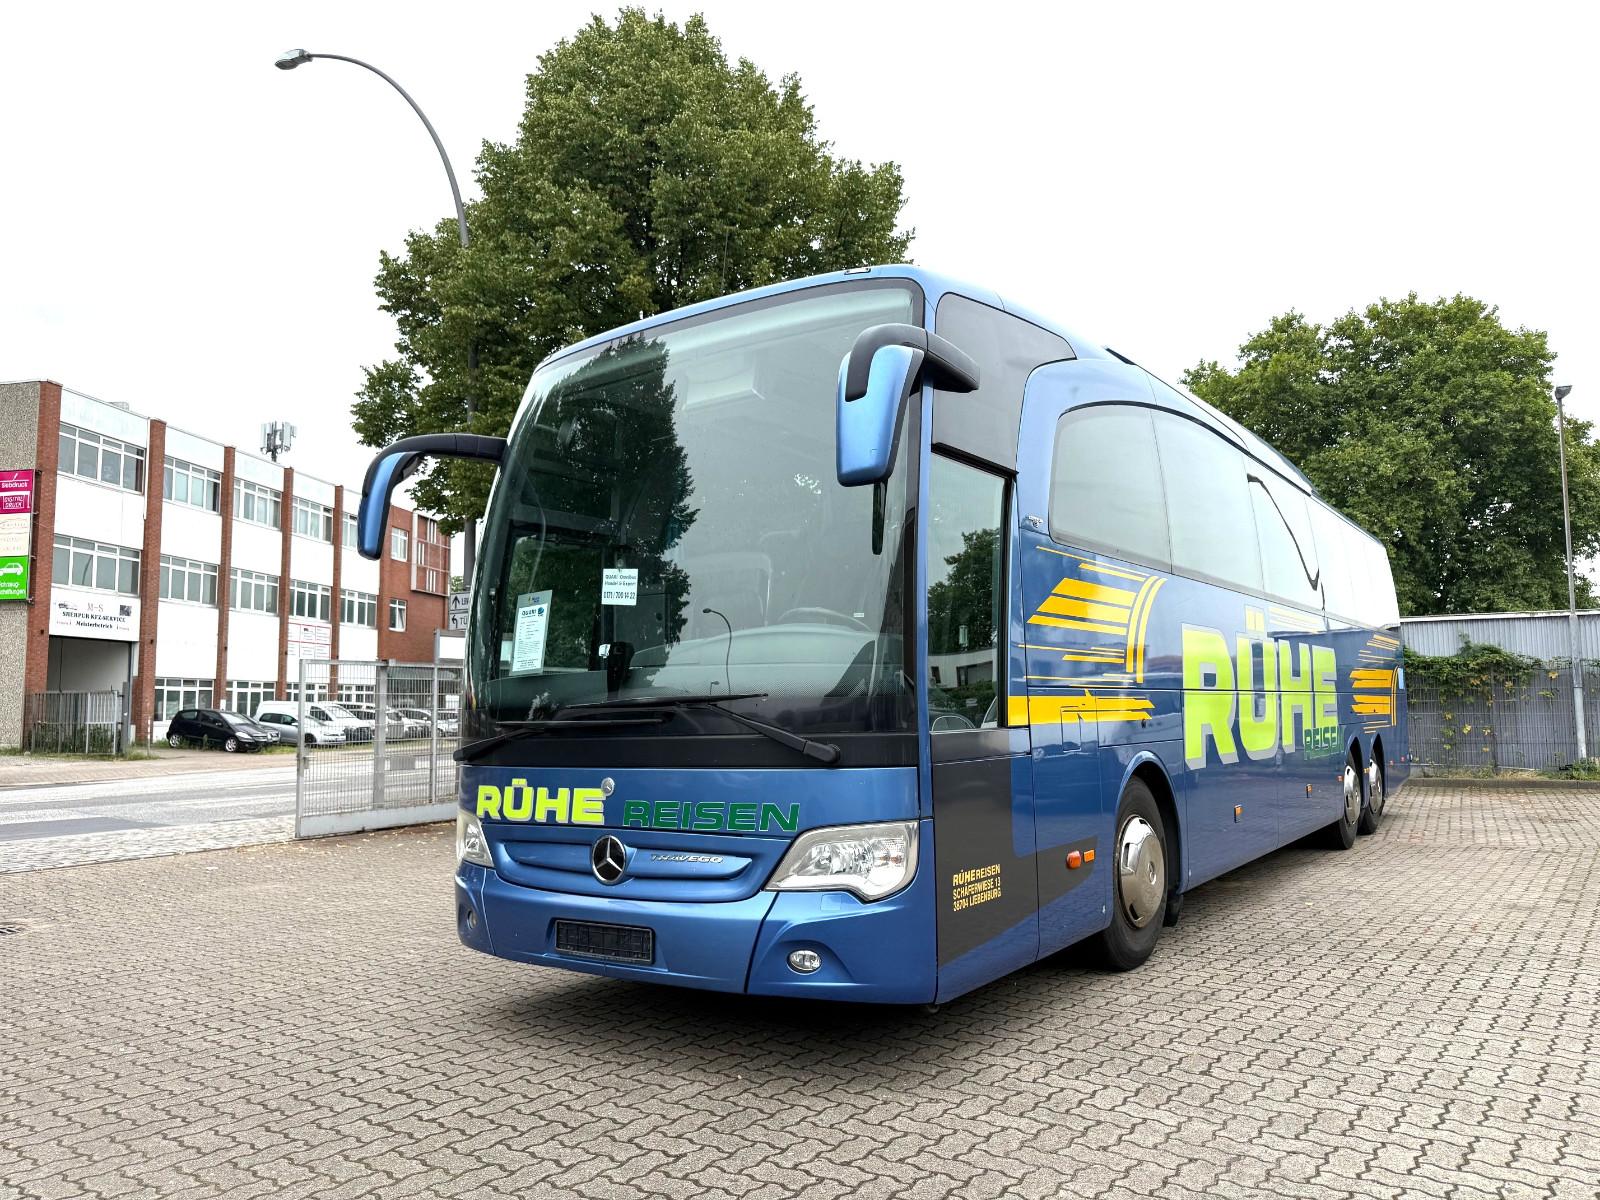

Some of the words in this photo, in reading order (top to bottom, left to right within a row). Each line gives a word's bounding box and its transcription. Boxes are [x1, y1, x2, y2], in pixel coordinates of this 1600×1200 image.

[75, 620, 113, 629] Meisterbetrieb
[1181, 604, 1340, 771] RÜHE
[1303, 725, 1345, 761] REISEN
[475, 778, 606, 825] RÜHE
[622, 799, 800, 832] REISEN
